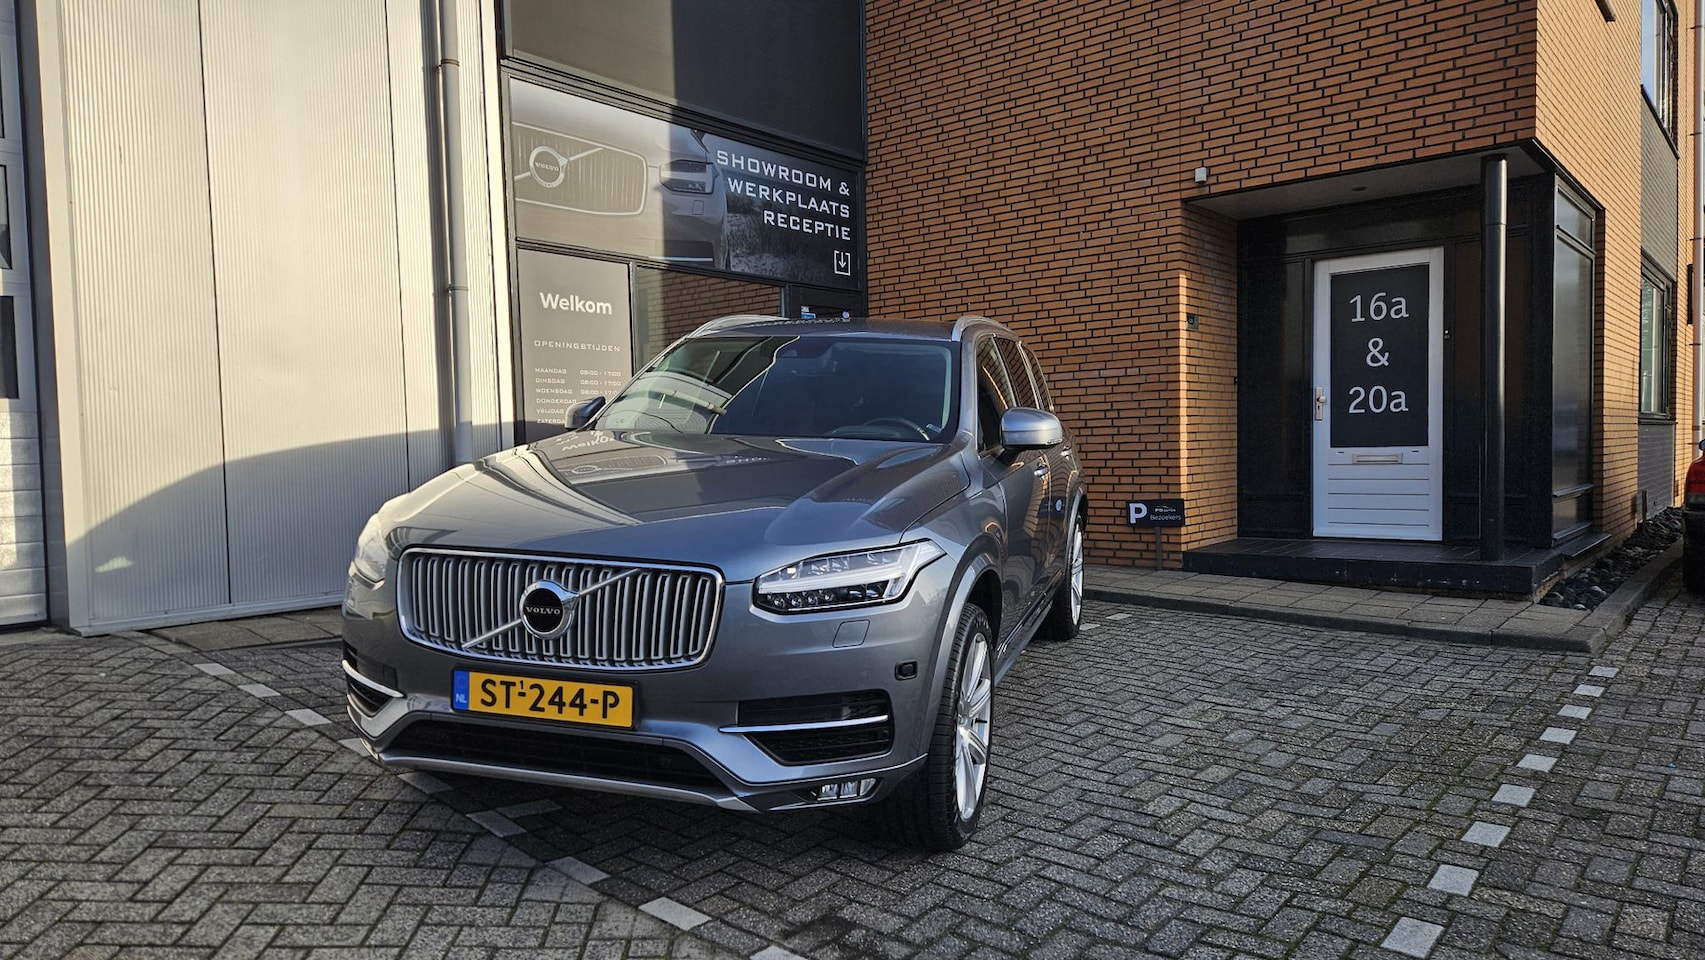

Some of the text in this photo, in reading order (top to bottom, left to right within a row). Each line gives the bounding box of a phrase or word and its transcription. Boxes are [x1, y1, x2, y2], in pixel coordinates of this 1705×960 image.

[534, 161, 560, 172] VOLVO
[716, 150, 850, 196] SHOWROOM &
[727, 177, 850, 218] WERKPLAATS
[763, 210, 851, 241] RECEPTIE
[539, 292, 613, 315] Welkom
[1349, 292, 1409, 322] 16a
[533, 340, 621, 352] OPENINGSTIJDEN
[1365, 337, 1389, 367] &
[535, 387, 573, 395] WOENSDAG
[1348, 385, 1409, 414] 20a
[1129, 503, 1148, 524] P
[525, 605, 561, 616] VOLVO
[456, 693, 468, 704] NL
